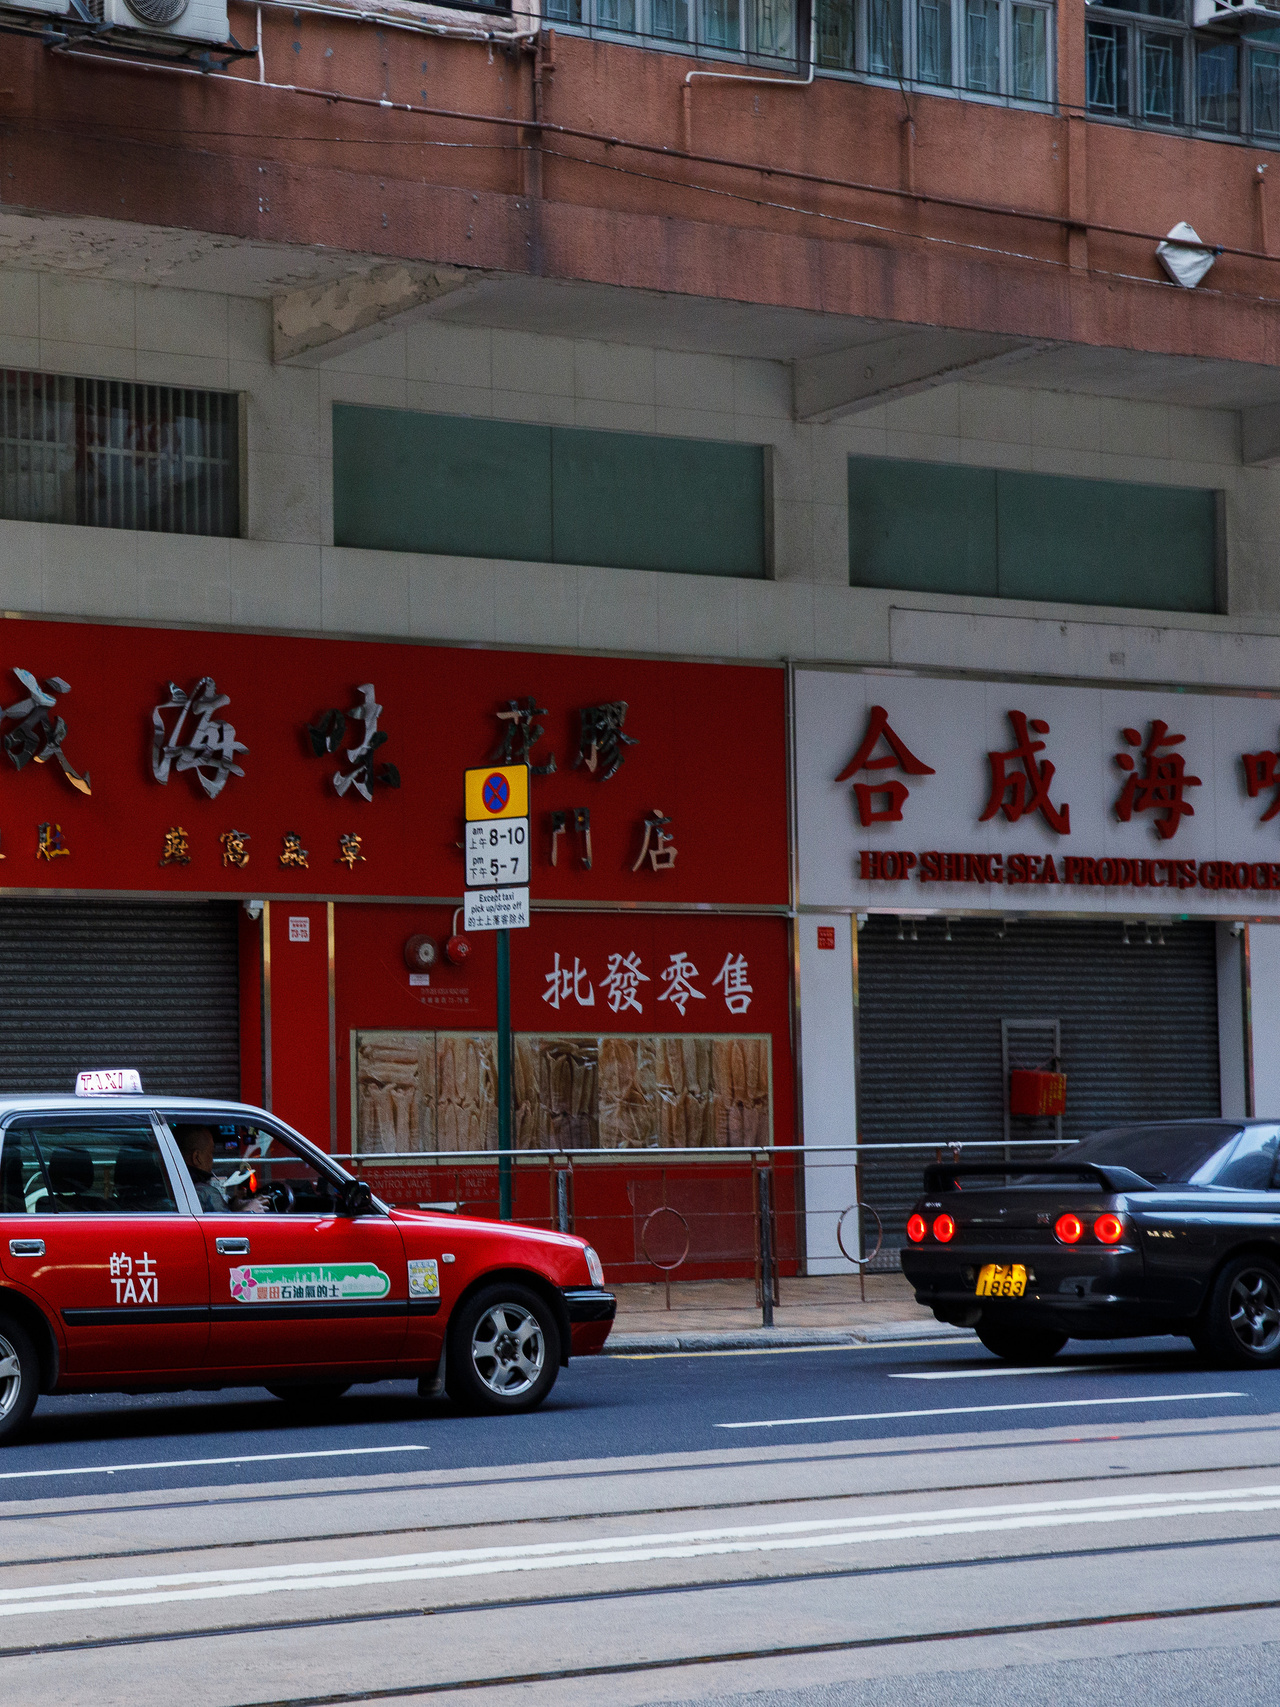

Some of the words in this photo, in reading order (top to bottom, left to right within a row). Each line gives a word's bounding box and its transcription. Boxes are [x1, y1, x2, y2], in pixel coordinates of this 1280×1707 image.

[493, 696, 640, 782] 花膠
[472, 827, 484, 836] am
[489, 826, 525, 847] 8-10
[469, 838, 487, 850] 上午
[472, 857, 484, 867] pm
[859, 850, 917, 881] HOP
[919, 850, 1005, 883] SHING
[1007, 853, 1060, 884] SEA
[1063, 855, 1198, 888] PRODUCTS
[469, 868, 487, 880] 下午
[479, 893, 501, 903] Except
[502, 892, 515, 901] taxi
[471, 905, 484, 915] pick
[512, 901, 522, 911] off
[542, 951, 754, 1016] 批發零售
[80, 1072, 123, 1091] TAXI
[109, 1251, 157, 1278] 的士
[111, 1278, 159, 1304] TAXI
[982, 1279, 1024, 1296] 1883
